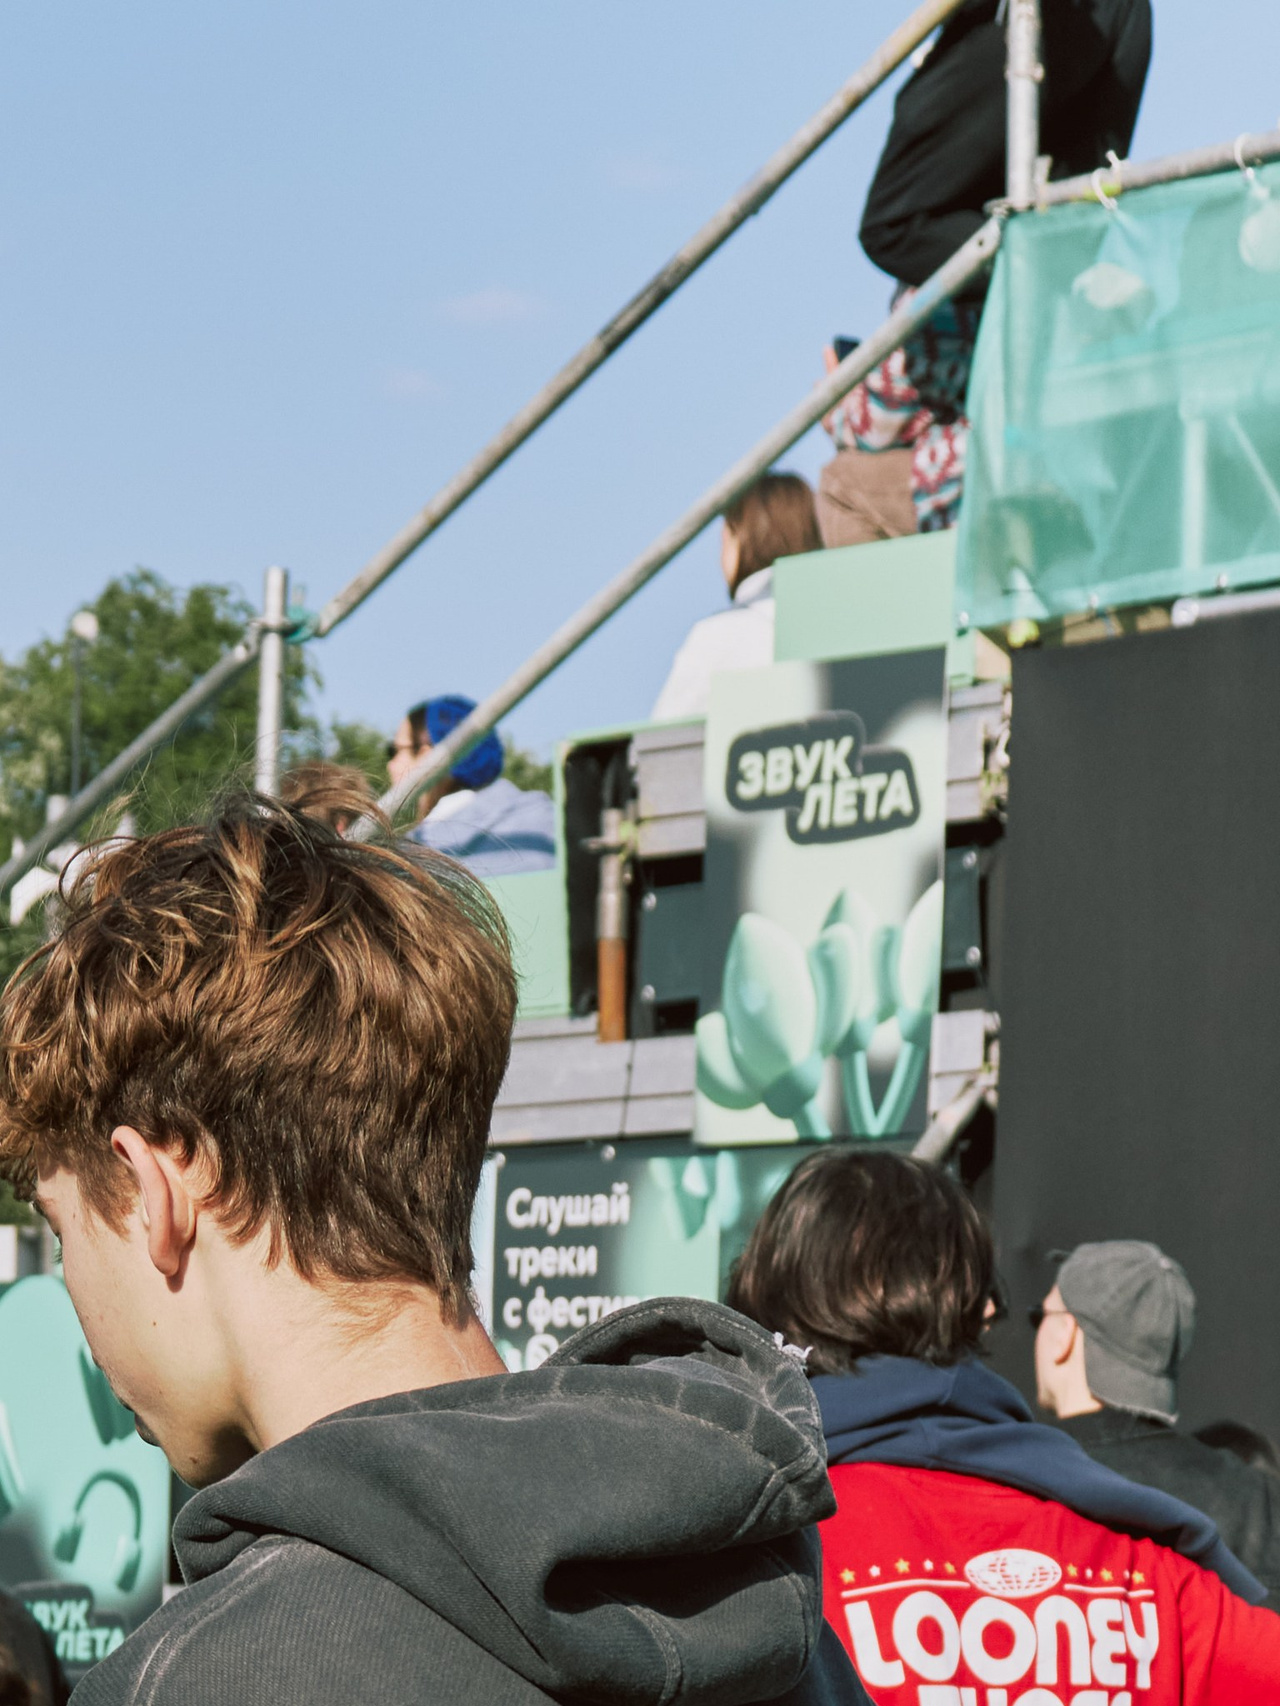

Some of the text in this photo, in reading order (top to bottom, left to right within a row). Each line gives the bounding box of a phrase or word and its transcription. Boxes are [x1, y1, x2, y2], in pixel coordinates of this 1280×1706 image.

[736, 735, 854, 800] ЗВУК
[797, 769, 914, 833] ЛЕТА
[506, 1182, 630, 1236] Слушай
[504, 1245, 597, 1286] треки
[503, 1297, 522, 1328] с
[24, 1599, 90, 1631] ВУК
[844, 1591, 1159, 1689] LOONEY
